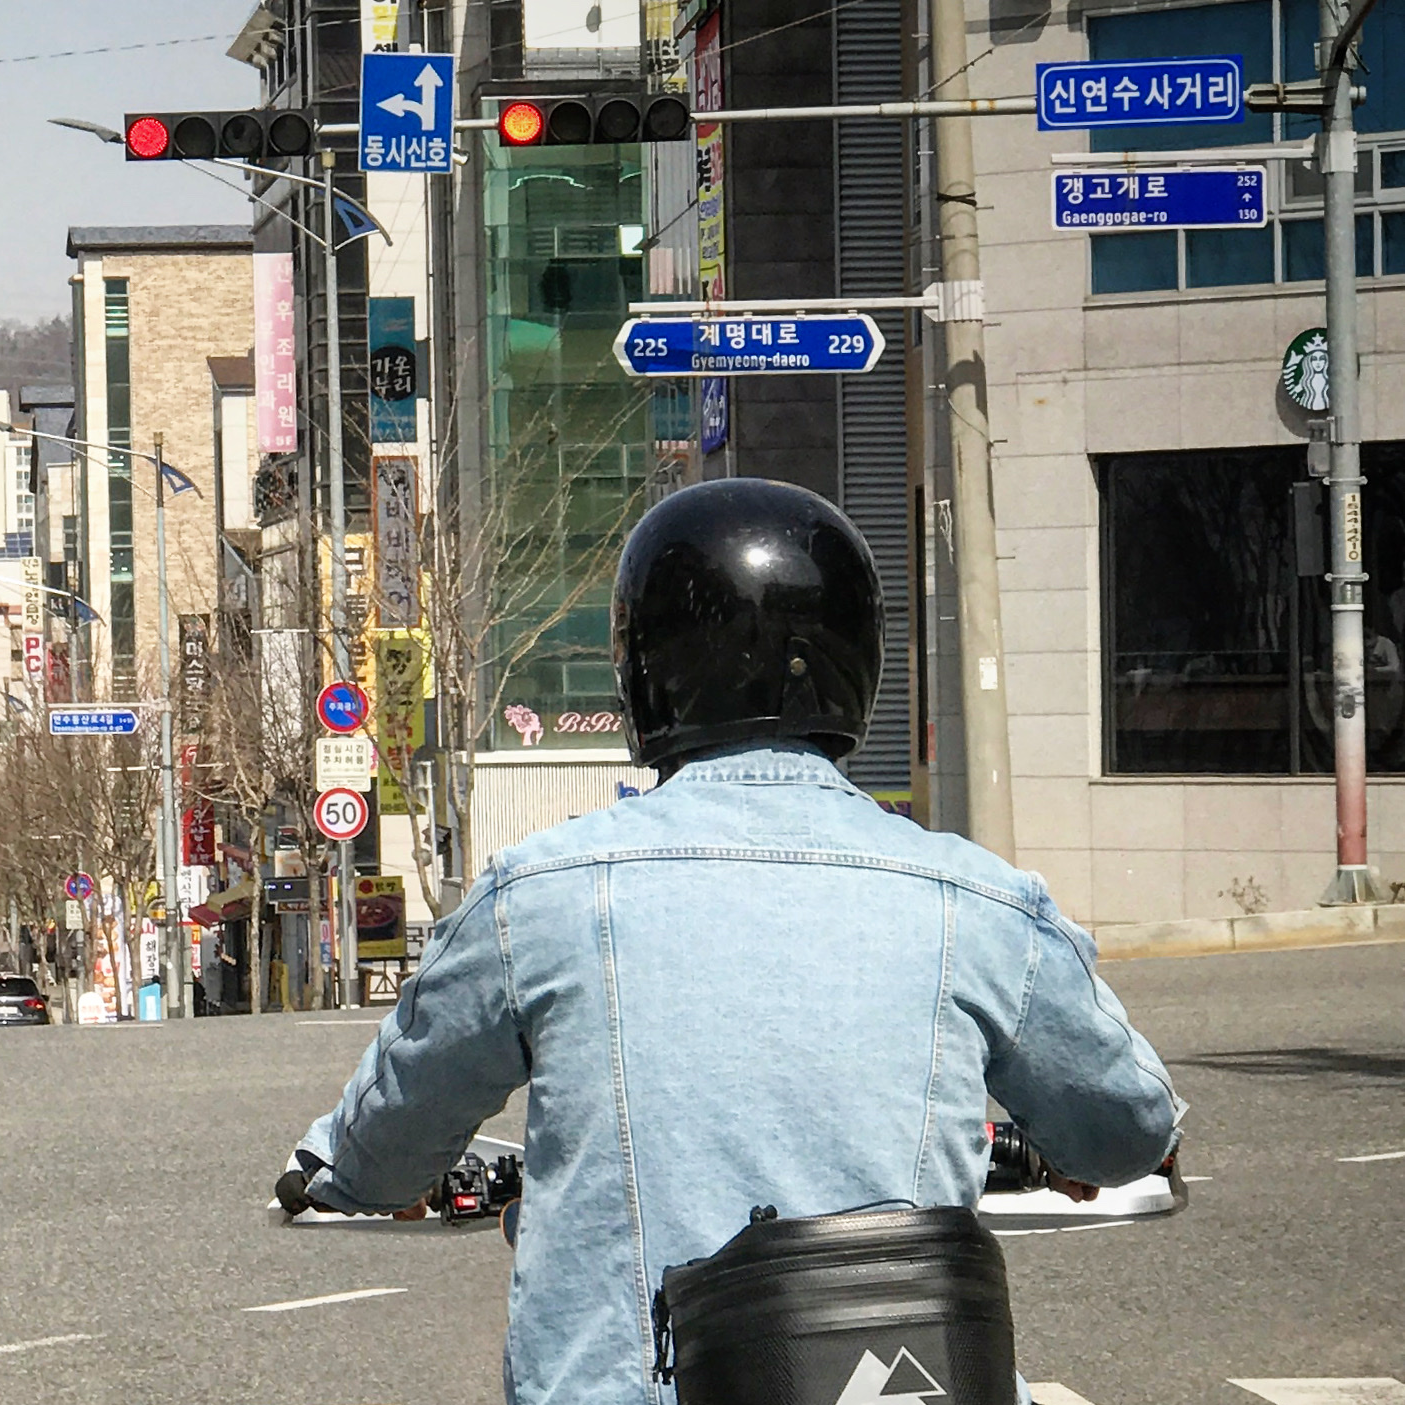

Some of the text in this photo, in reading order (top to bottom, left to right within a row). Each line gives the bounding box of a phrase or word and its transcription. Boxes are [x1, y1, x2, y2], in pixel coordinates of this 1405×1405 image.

[1049, 71, 1233, 114] 신연수사거리
[364, 134, 447, 168] 동시신호
[1062, 175, 1169, 205] 갱고개로
[1236, 175, 1258, 187] 252
[1062, 209, 1168, 226] Gaenggogae-ro
[1238, 209, 1258, 220] 130
[699, 323, 800, 350] 계명대로
[828, 335, 865, 354] 229
[633, 338, 668, 357] 225
[372, 355, 411, 376] 가온
[691, 353, 810, 371] Gyemyeong-daero
[375, 376, 412, 394] 누리
[553, 711, 623, 733] BiBi
[326, 802, 357, 826] 50
